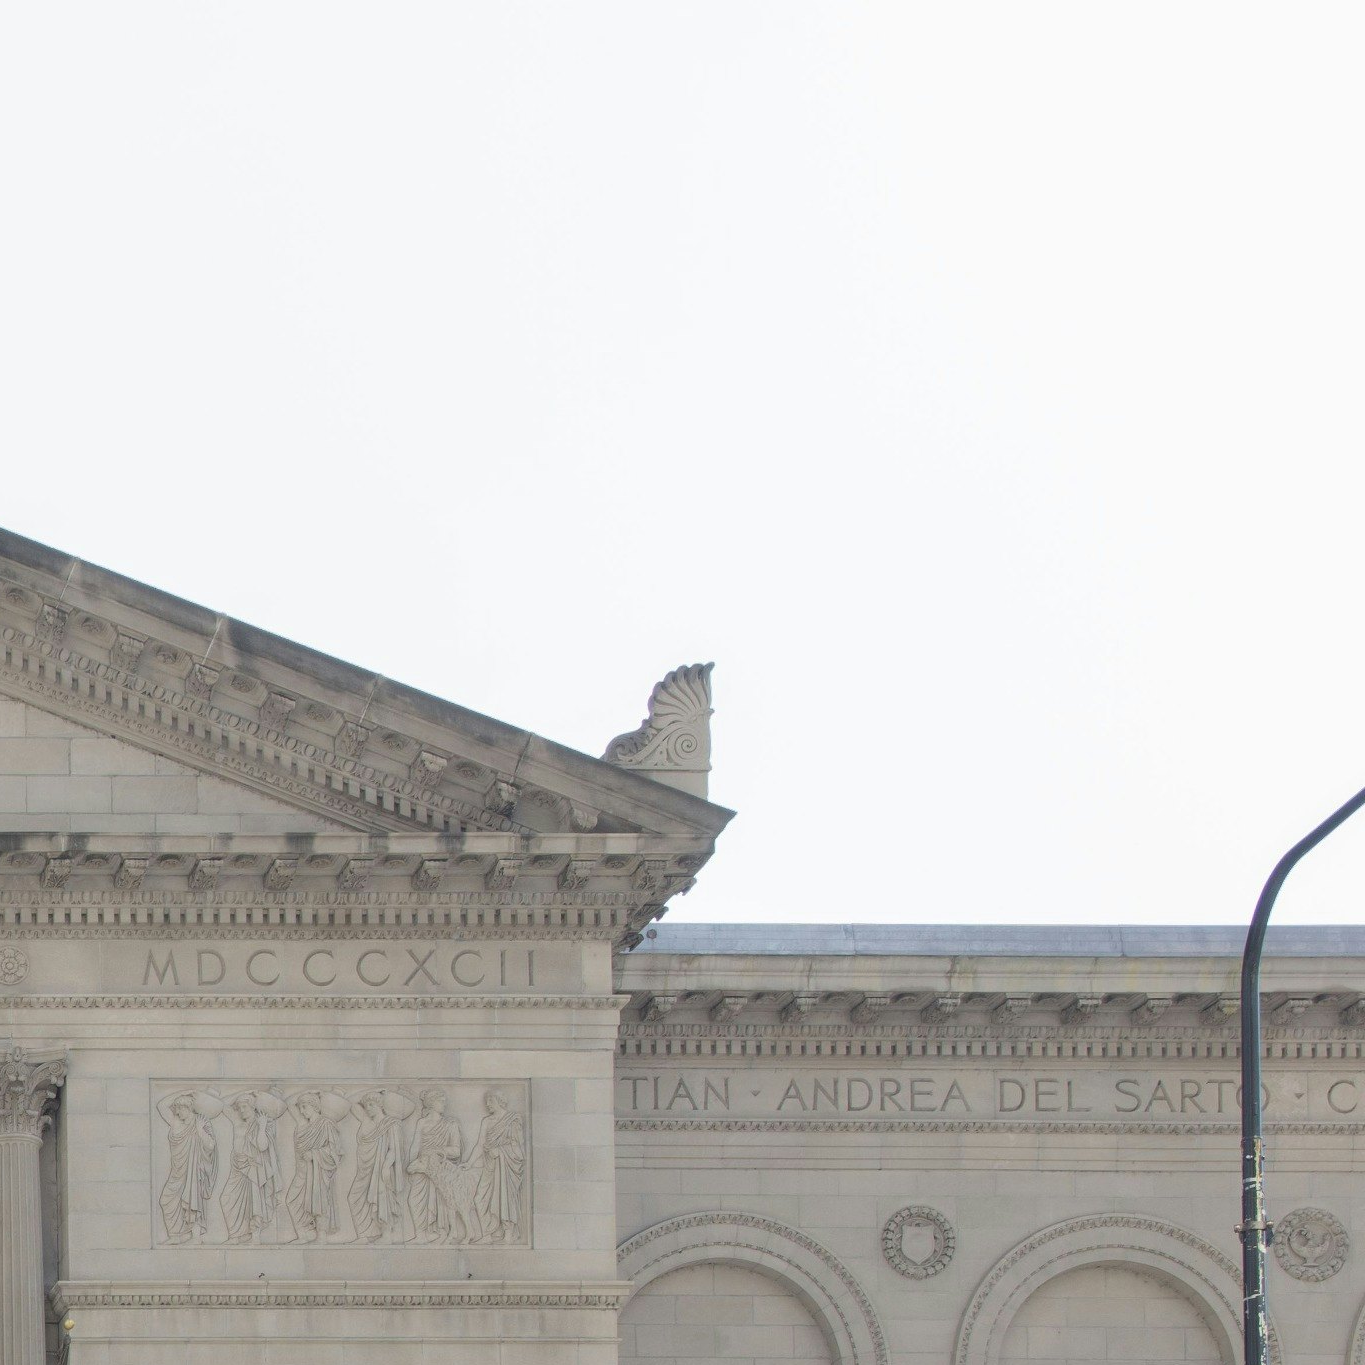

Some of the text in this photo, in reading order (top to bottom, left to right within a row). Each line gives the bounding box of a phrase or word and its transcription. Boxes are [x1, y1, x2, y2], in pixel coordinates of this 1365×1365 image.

[141, 947, 536, 987] MDCCCXCII
[619, 1075, 730, 1111] TIAN
[775, 1077, 973, 1112] ANDREA
[998, 1078, 1092, 1113] DEL
